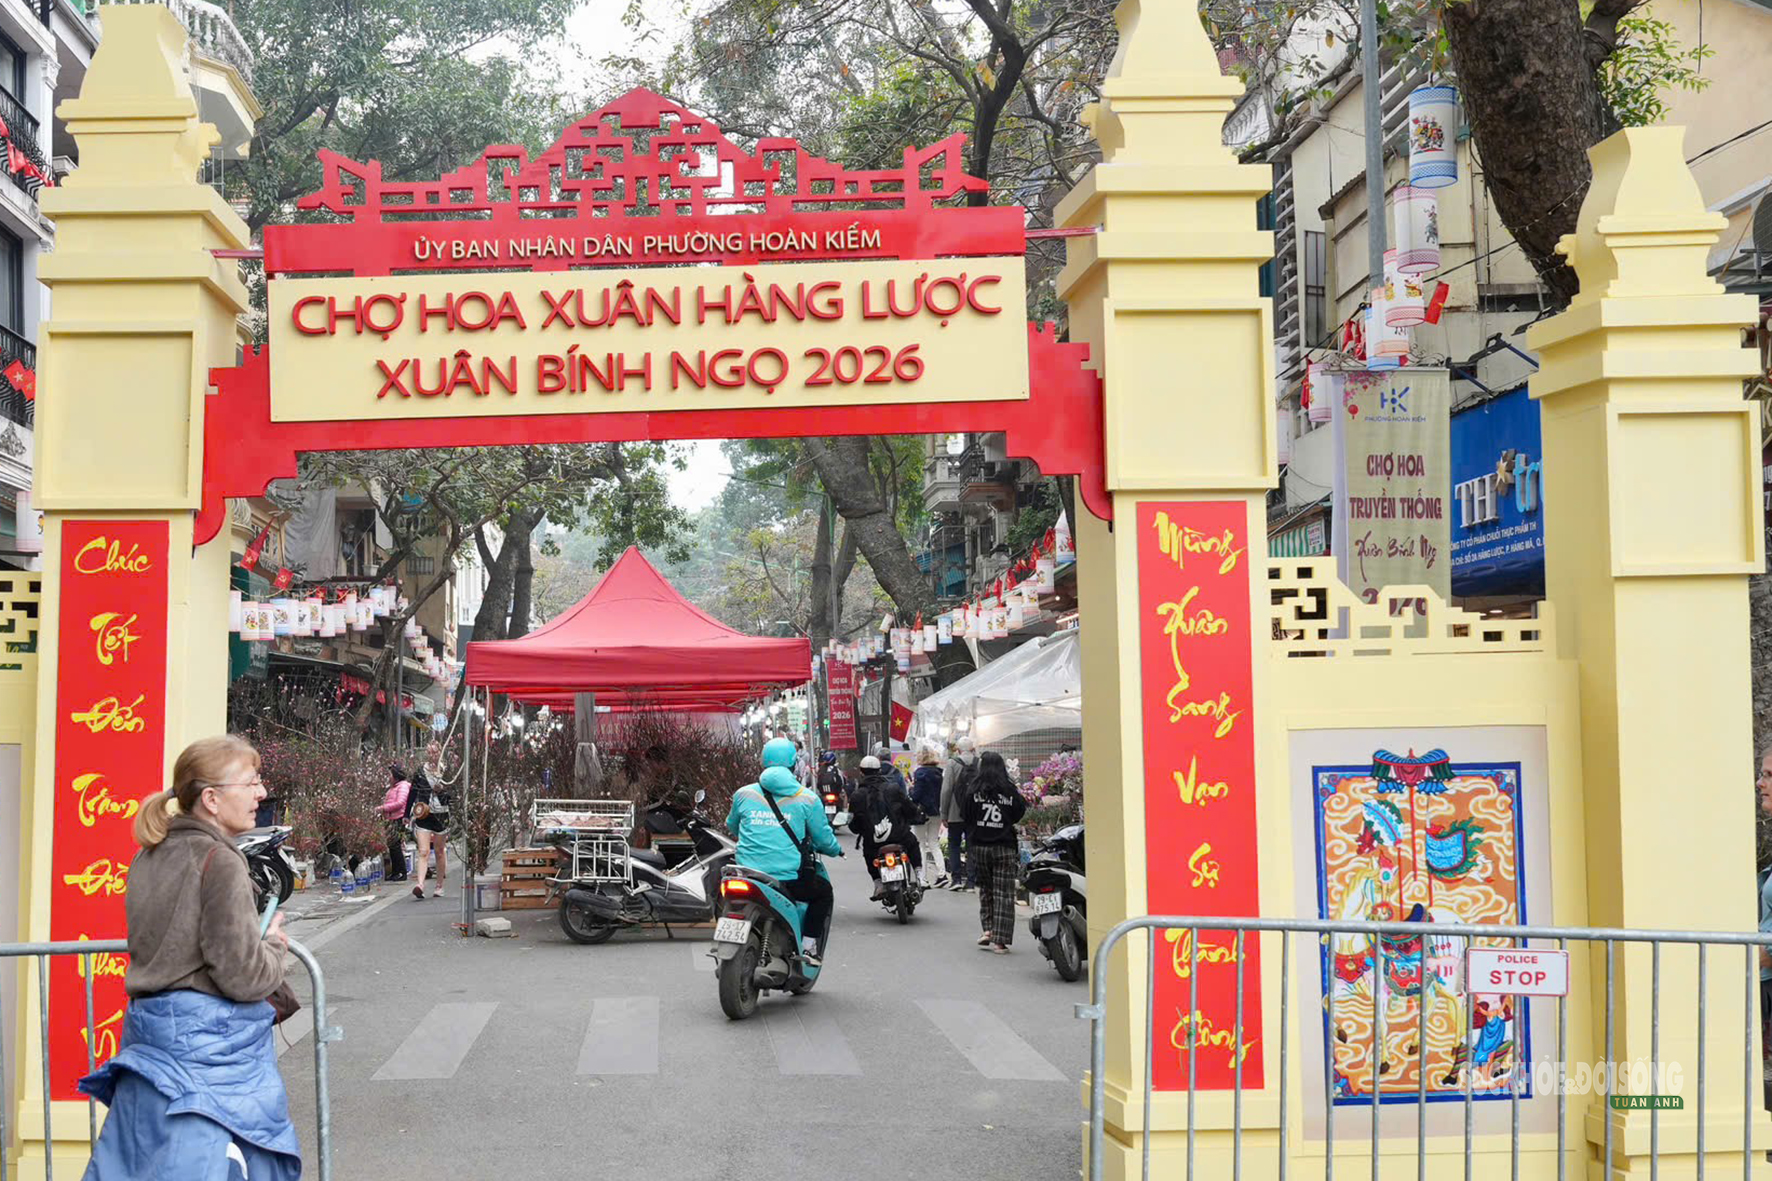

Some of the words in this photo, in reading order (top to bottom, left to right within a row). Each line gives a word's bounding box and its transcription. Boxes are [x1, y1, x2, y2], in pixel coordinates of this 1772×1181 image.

[413, 236, 447, 261] ỦY
[451, 239, 500, 259] BAN
[508, 235, 575, 258] NHÂN
[583, 236, 633, 257] DÂN
[643, 231, 744, 255] PHƯỜNG
[750, 228, 818, 251] HOÀN
[825, 221, 882, 250] KIẾM
[292, 292, 407, 341] CHỢ
[419, 290, 527, 332] HOA
[540, 279, 681, 328] XUÂN
[697, 271, 844, 325] HÀNG
[861, 272, 1003, 327] LƯỢC
[376, 349, 517, 399] XUÂN
[537, 344, 652, 393] BÍNH
[671, 347, 789, 394] NGỌ
[804, 343, 925, 386] 2026
[1366, 451, 1394, 481] CHỢ
[1397, 454, 1425, 477] HOA
[1350, 487, 1396, 519] TRUYỀN
[1400, 487, 1442, 520] THỐNG
[1455, 473, 1499, 528] TH
[1513, 453, 1543, 513] tr
[74, 536, 152, 574] Chúc
[1154, 511, 1246, 575] Mừng
[89, 612, 141, 665] Tết
[1156, 585, 1229, 682] Xuân
[70, 694, 145, 733] Đến
[833, 711, 851, 720] 2026
[1166, 674, 1245, 738] Sang
[1173, 754, 1228, 806] Vạn
[982, 803, 1002, 823] 76
[63, 859, 129, 895] Điề
[1489, 970, 1547, 986] STOP
[1497, 954, 1538, 964] POLICE
